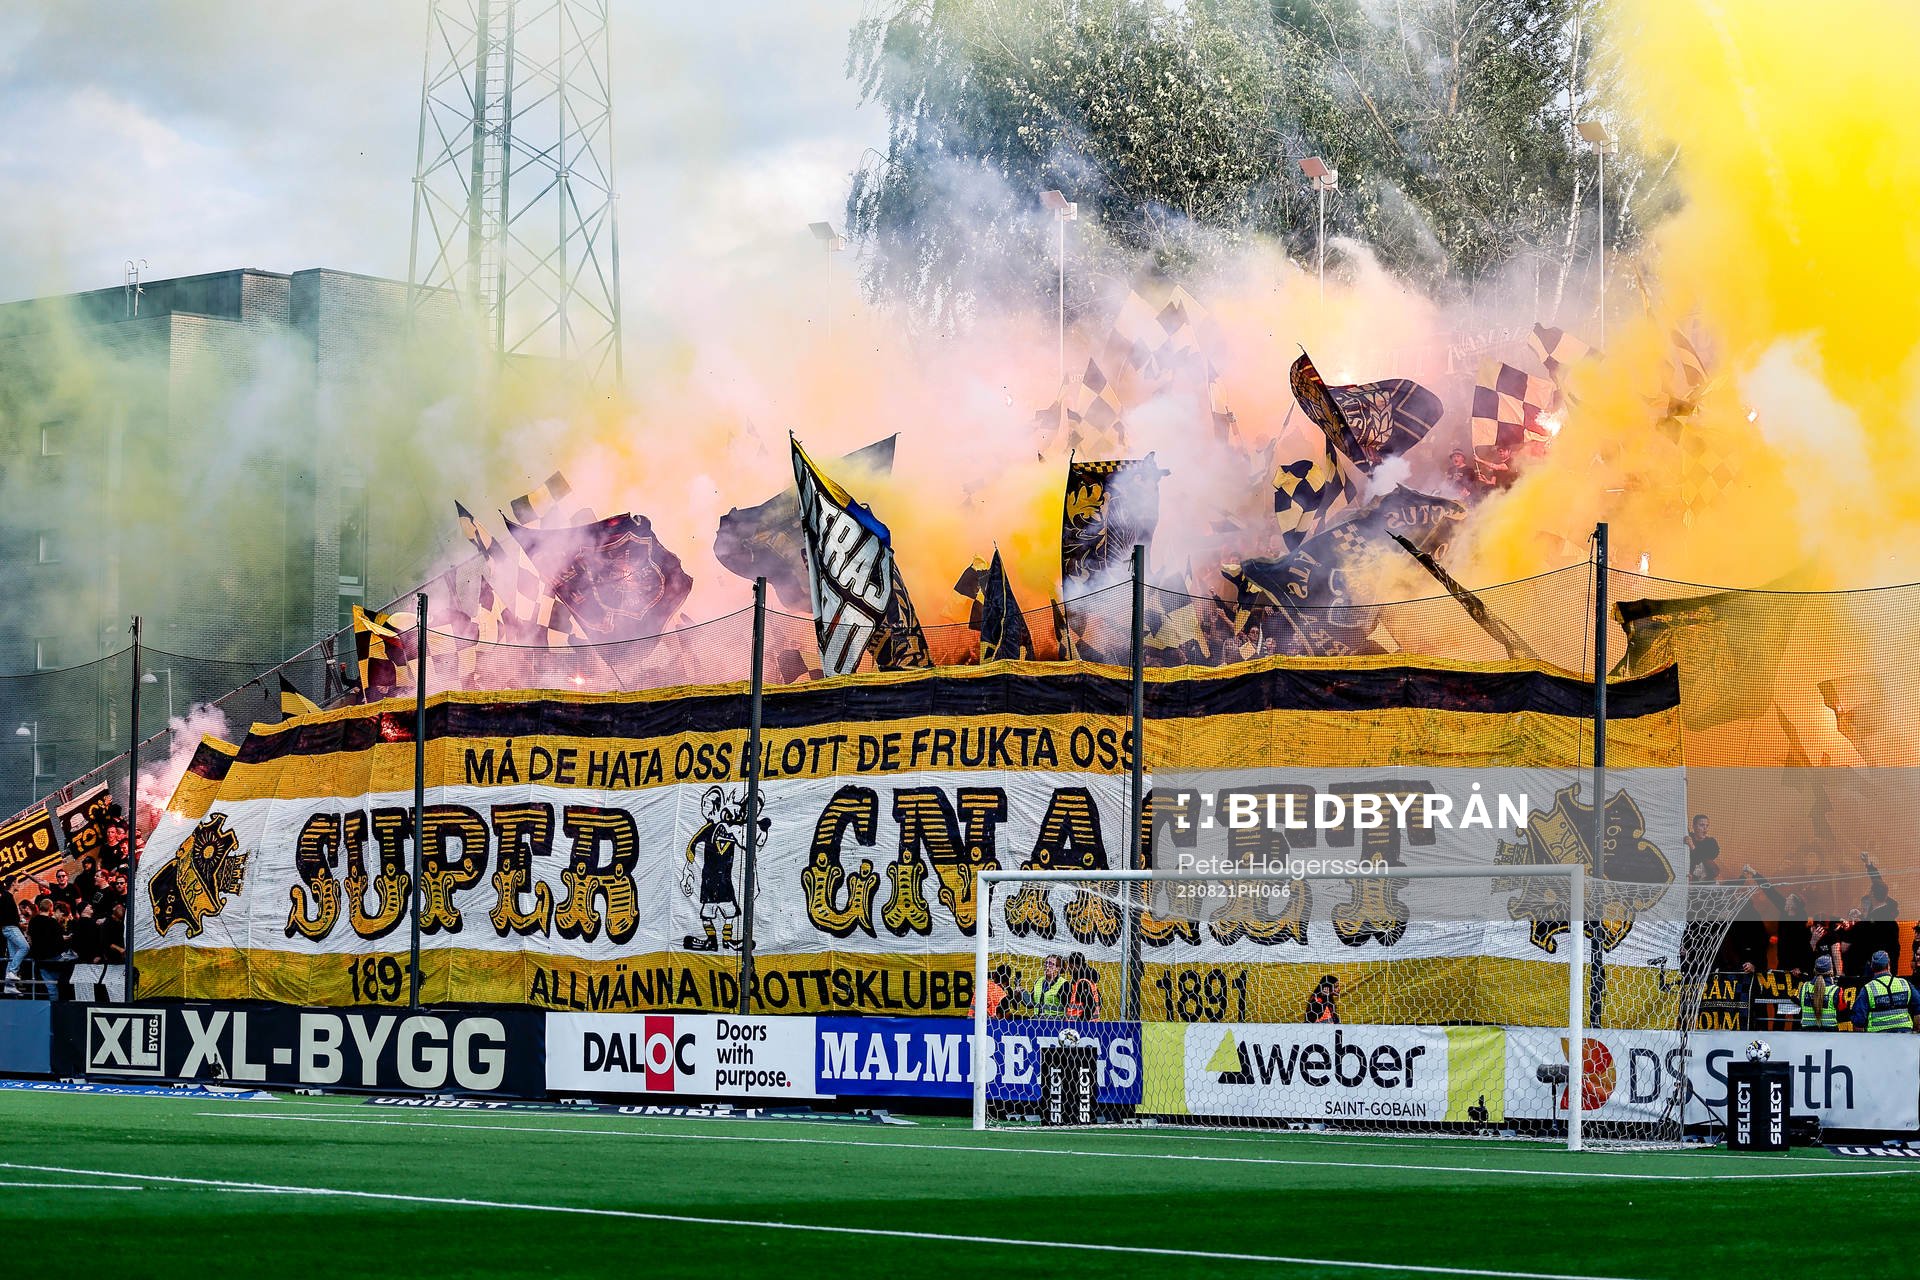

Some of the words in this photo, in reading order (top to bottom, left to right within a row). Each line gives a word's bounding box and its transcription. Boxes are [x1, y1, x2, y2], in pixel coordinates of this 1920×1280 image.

[464, 739, 519, 785] MÅ
[528, 745, 577, 785] DE
[587, 747, 663, 788] HATA
[740, 734, 847, 778] BLOTT
[857, 733, 901, 771] DE
[909, 726, 1058, 768] FRUKTA
[284, 802, 640, 945] SUPER
[530, 964, 700, 1011] ALLMÄNNA
[1155, 968, 1248, 1023] 1891
[92, 1016, 158, 1067] XL
[178, 1010, 506, 1091] XL-BYGG
[583, 1032, 696, 1076] DALOC
[716, 1019, 767, 1042] Doors
[716, 1043, 754, 1065] with
[1252, 1029, 1426, 1088] weber
[715, 1068, 792, 1092] purpose.
[821, 1031, 1137, 1089] MALMBES
[1629, 1047, 1694, 1108] DS
[373, 1096, 508, 1111] UNIBET
[618, 1105, 764, 1119] UNIBET
[1049, 1066, 1063, 1124] SELECT
[1079, 1066, 1091, 1123] SELECT
[1325, 1100, 1427, 1118] SAINT-GOBAIN
[1737, 1081, 1751, 1145] SELECT
[1770, 1081, 1782, 1145] SELECT
